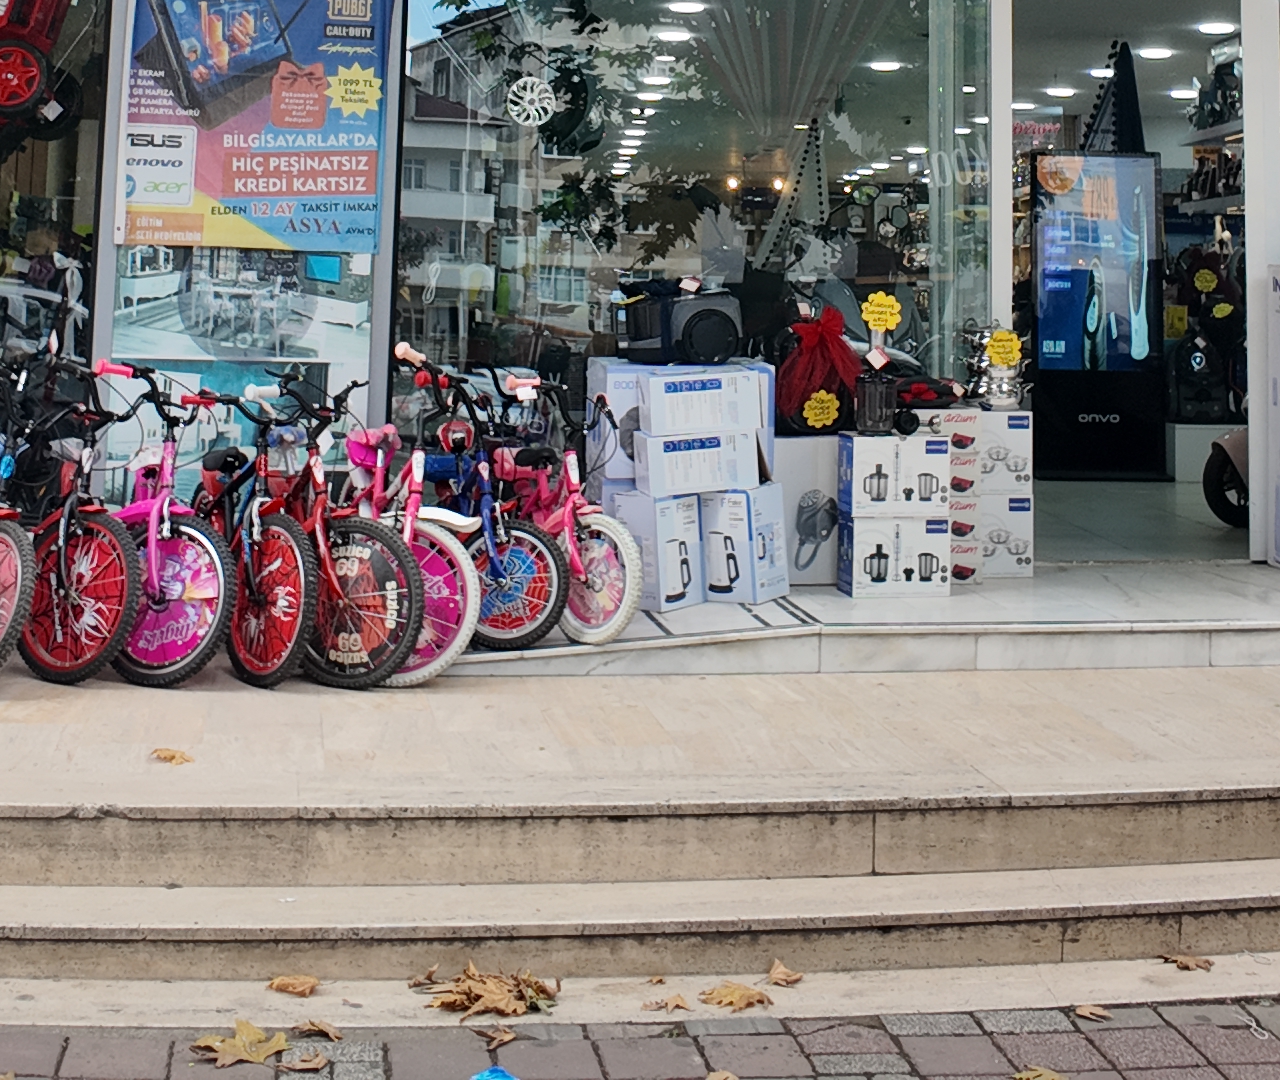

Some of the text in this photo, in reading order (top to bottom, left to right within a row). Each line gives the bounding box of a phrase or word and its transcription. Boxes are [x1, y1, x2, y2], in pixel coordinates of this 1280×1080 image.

[138, 69, 165, 78] EKRAN
[137, 79, 155, 87] RAM
[338, 79, 374, 88] 1099 TL
[145, 89, 175, 97] HAFIZA
[140, 98, 173, 106] KAMERA
[140, 107, 175, 116] BATARYA
[176, 108, 200, 117] ÖMRÜ
[223, 130, 378, 148] BİLGİSAYARLAR'DA
[232, 153, 369, 176] HİÇ PEŞİNATSIZ
[143, 181, 188, 194] acer
[234, 174, 367, 193] KREDİ KARTSIZ
[211, 206, 247, 216] ELDEN
[251, 202, 270, 217] 12
[273, 202, 297, 217] AY
[301, 200, 340, 213] TAKSİT
[282, 217, 341, 235] ASYA
[943, 413, 977, 424] arzum
[1078, 413, 1120, 423] onvo
[331, 544, 372, 560] suzico
[385, 580, 400, 629] suzico
[328, 649, 369, 664] suzico
